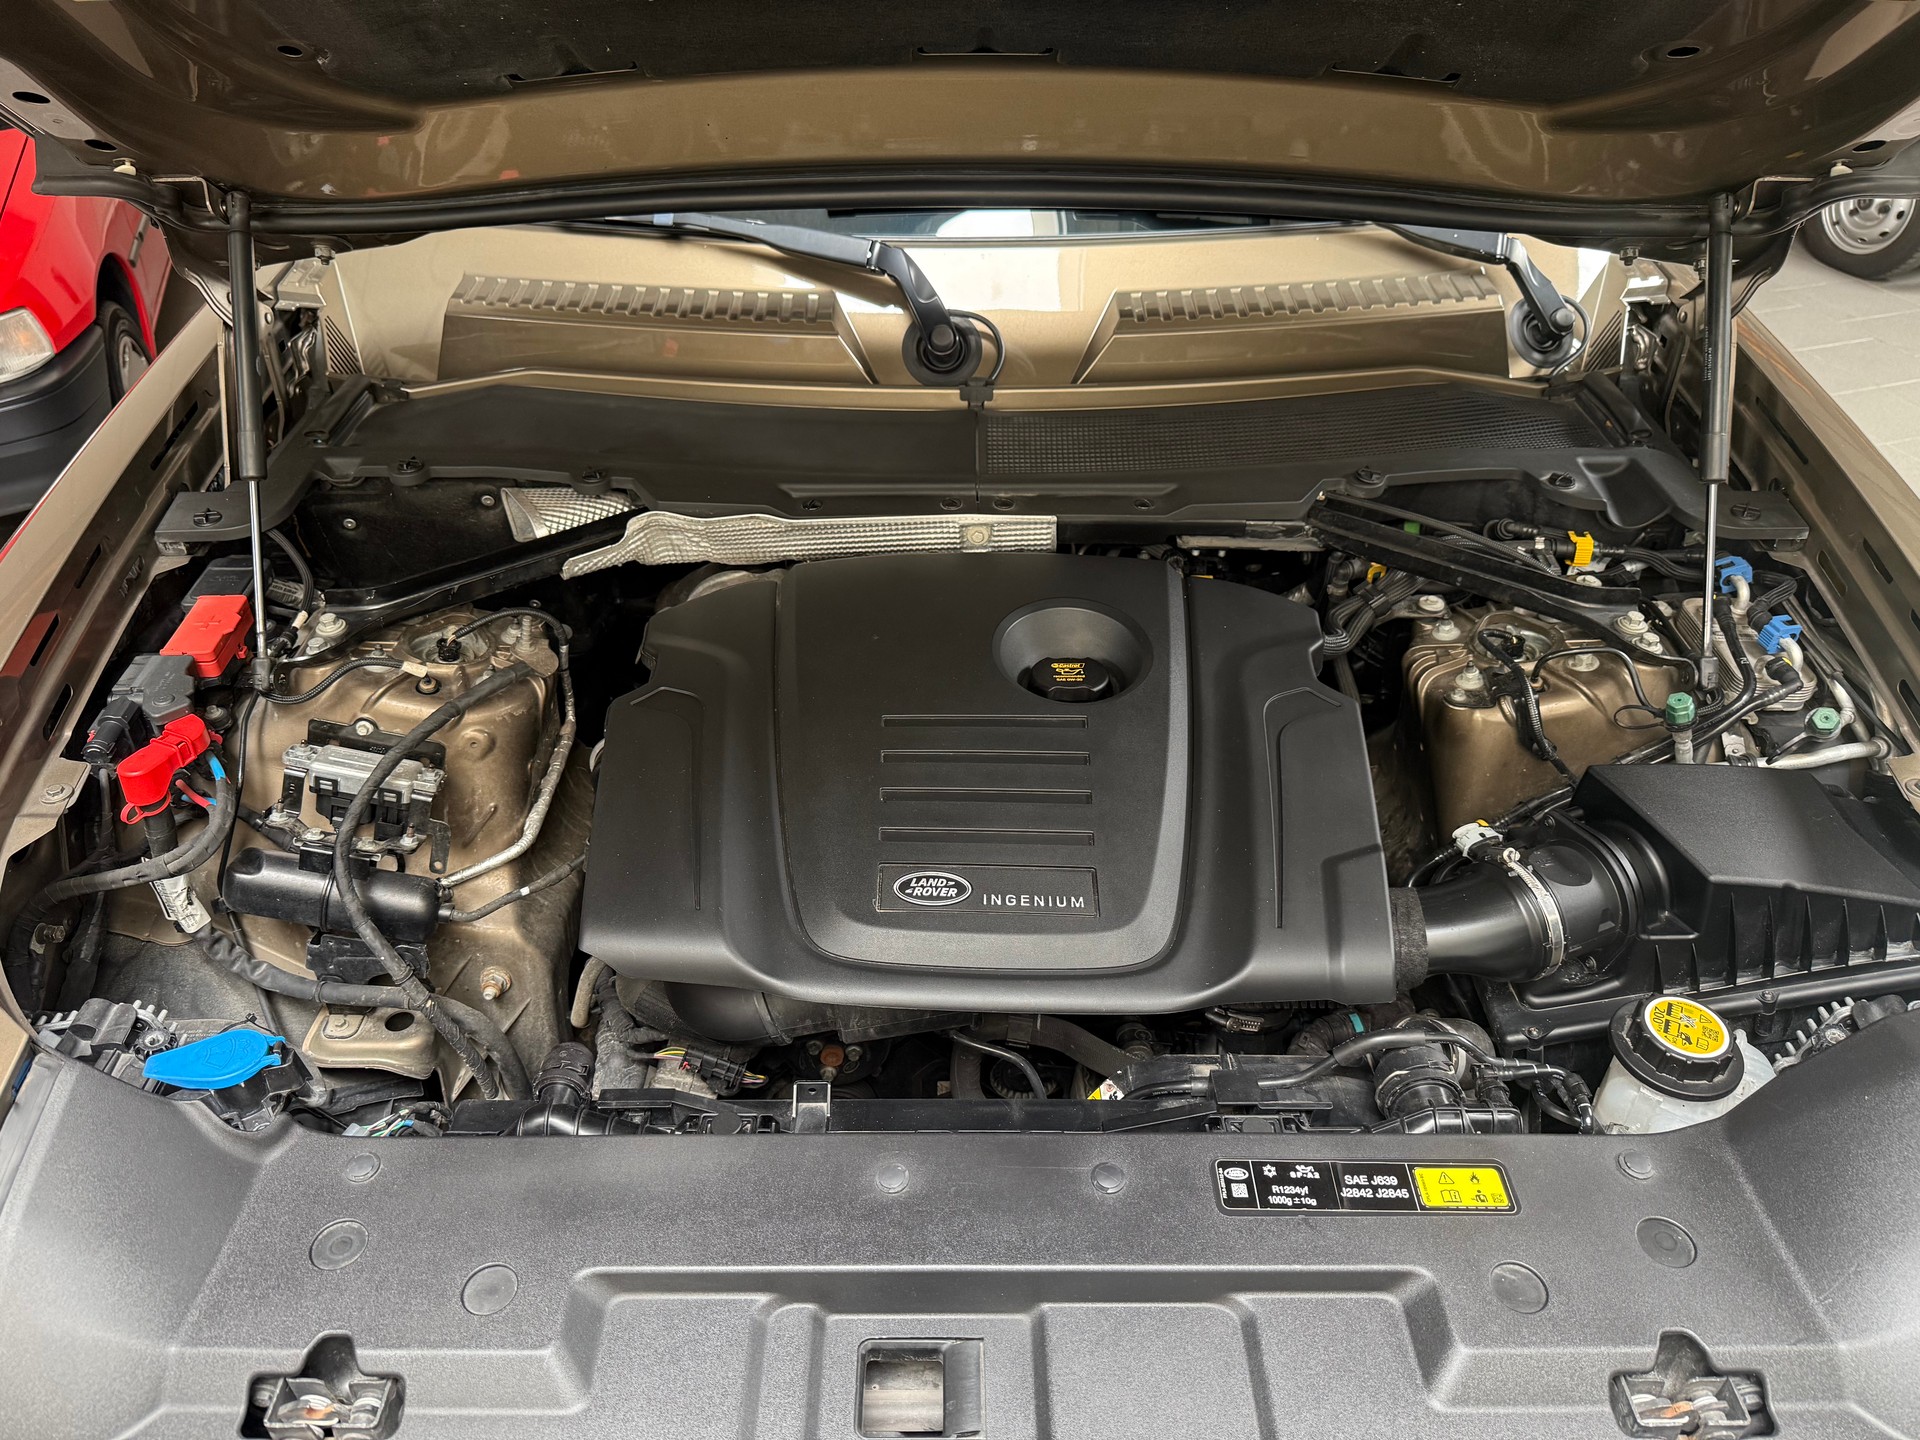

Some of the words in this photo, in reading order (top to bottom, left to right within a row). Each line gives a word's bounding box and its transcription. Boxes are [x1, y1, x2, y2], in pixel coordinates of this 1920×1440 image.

[910, 878, 949, 887] LAND
[912, 887, 958, 897] ROVER
[983, 894, 1085, 908] INGENIUM
[1653, 1006, 1666, 1024] 200
[1344, 1174, 1370, 1186] SAE
[1371, 1175, 1399, 1186] J639
[1271, 1185, 1309, 1196] R1234yf
[1340, 1187, 1374, 1198] J2842
[1375, 1188, 1410, 1199] J2845
[1267, 1196, 1293, 1206] 1000g
